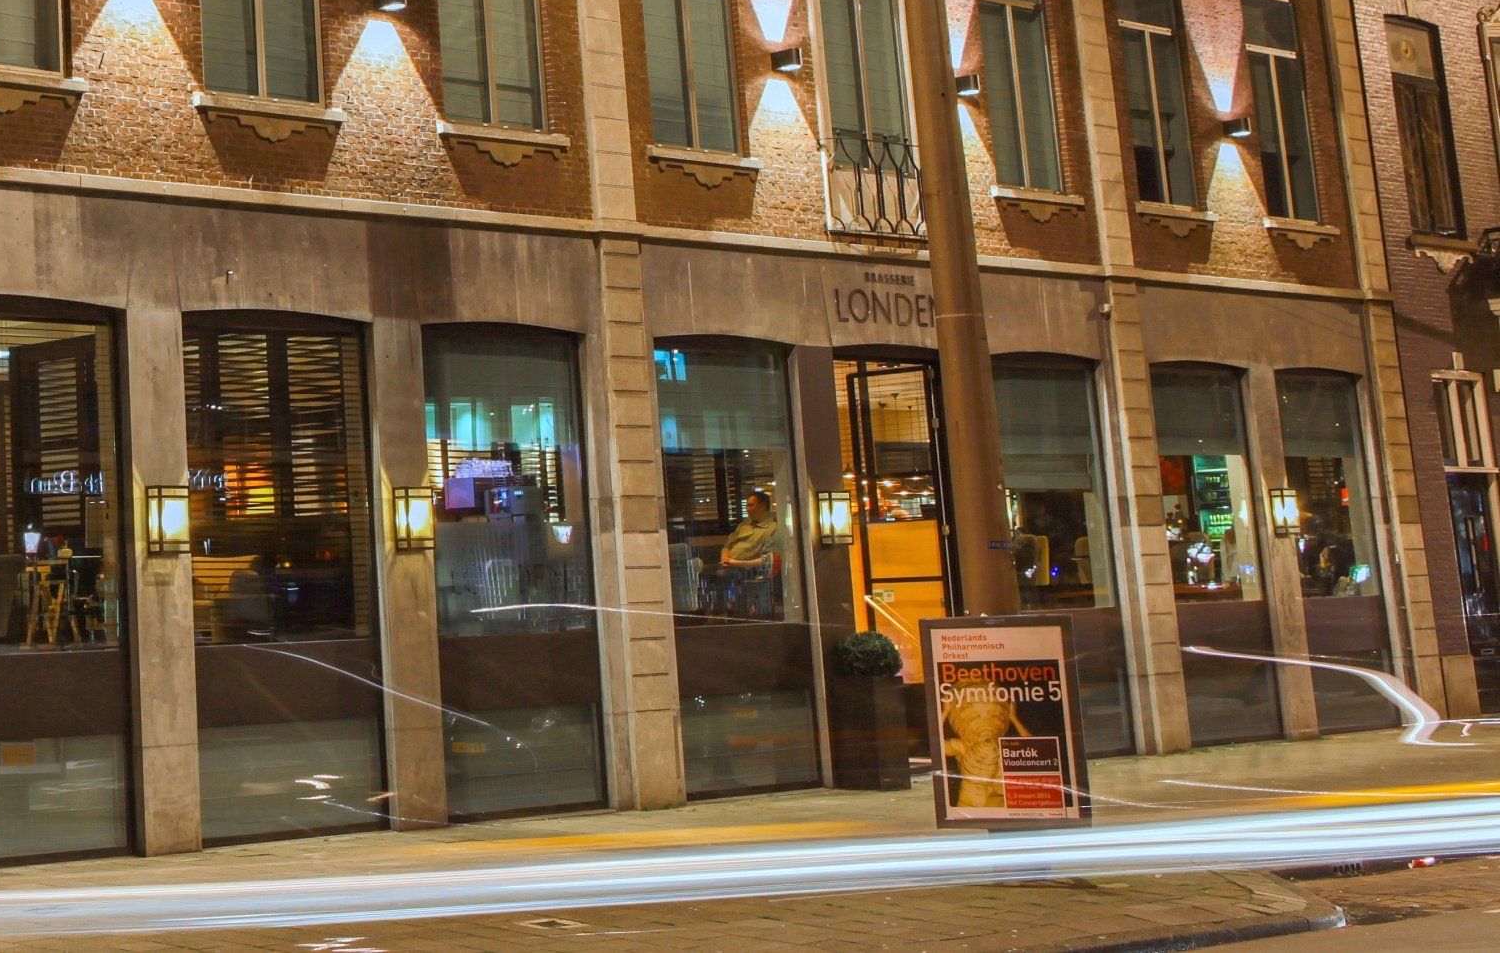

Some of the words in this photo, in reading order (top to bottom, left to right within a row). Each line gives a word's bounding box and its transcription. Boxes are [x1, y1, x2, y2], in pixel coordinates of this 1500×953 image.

[864, 271, 916, 287] BRASSERIE
[941, 634, 987, 642] Nederlands
[942, 642, 1005, 651] Philharmonisch
[942, 652, 969, 660] Orkest
[942, 662, 1056, 682] Beethoven
[940, 682, 1044, 707] Symfonie
[1048, 680, 1062, 702] 5
[1002, 748, 1038, 757] Bartók
[1053, 758, 1059, 766] 2
